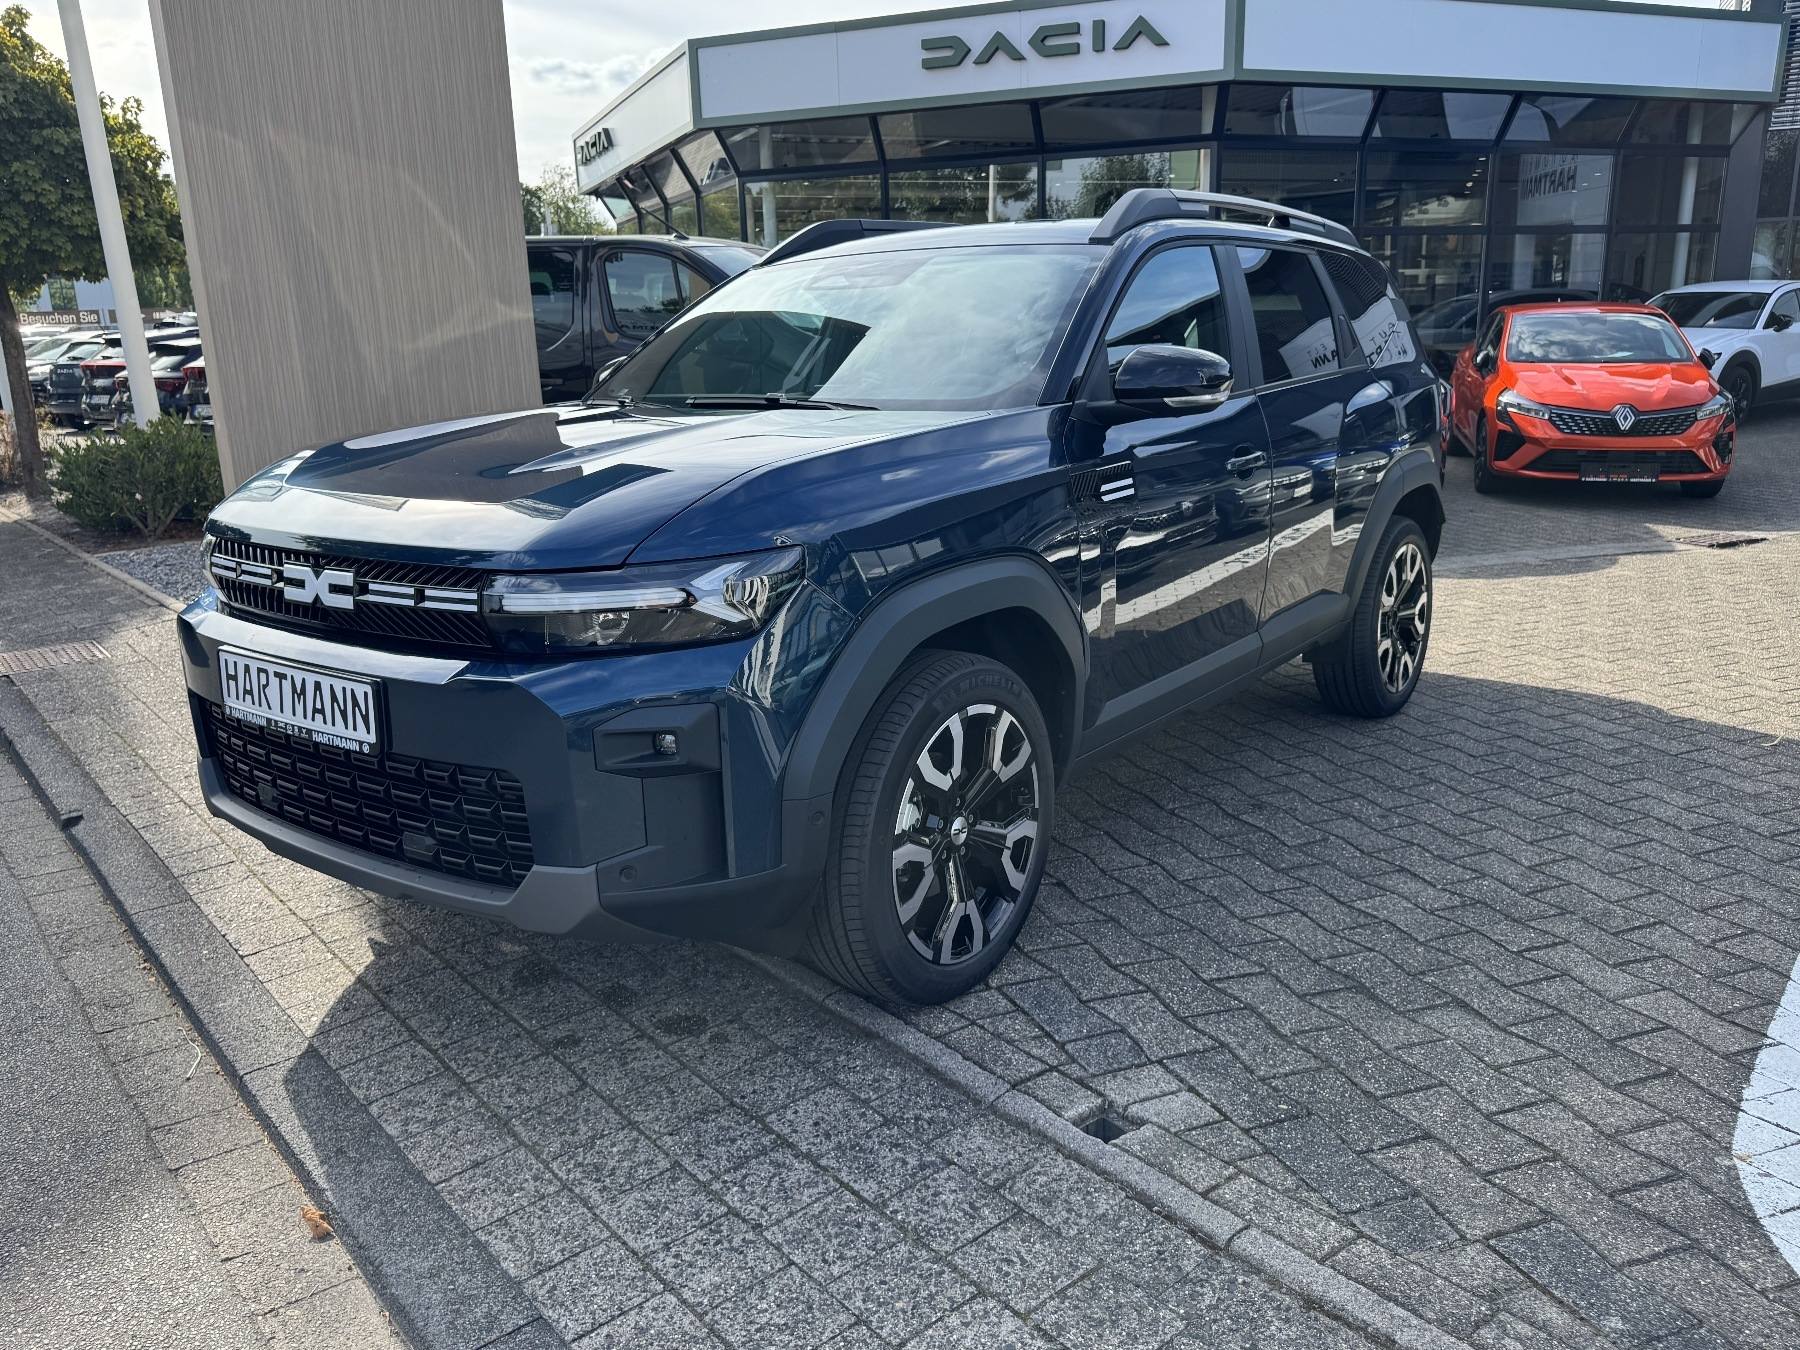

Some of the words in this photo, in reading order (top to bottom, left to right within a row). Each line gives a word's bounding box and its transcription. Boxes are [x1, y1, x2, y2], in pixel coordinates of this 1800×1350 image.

[921, 15, 1170, 70] DACIA
[20, 313, 77, 325] Besuchen
[80, 312, 98, 323] Sie
[224, 658, 371, 735] HARTMANN
[230, 708, 267, 728] HARTMANN
[312, 731, 360, 752] HARTMANN
